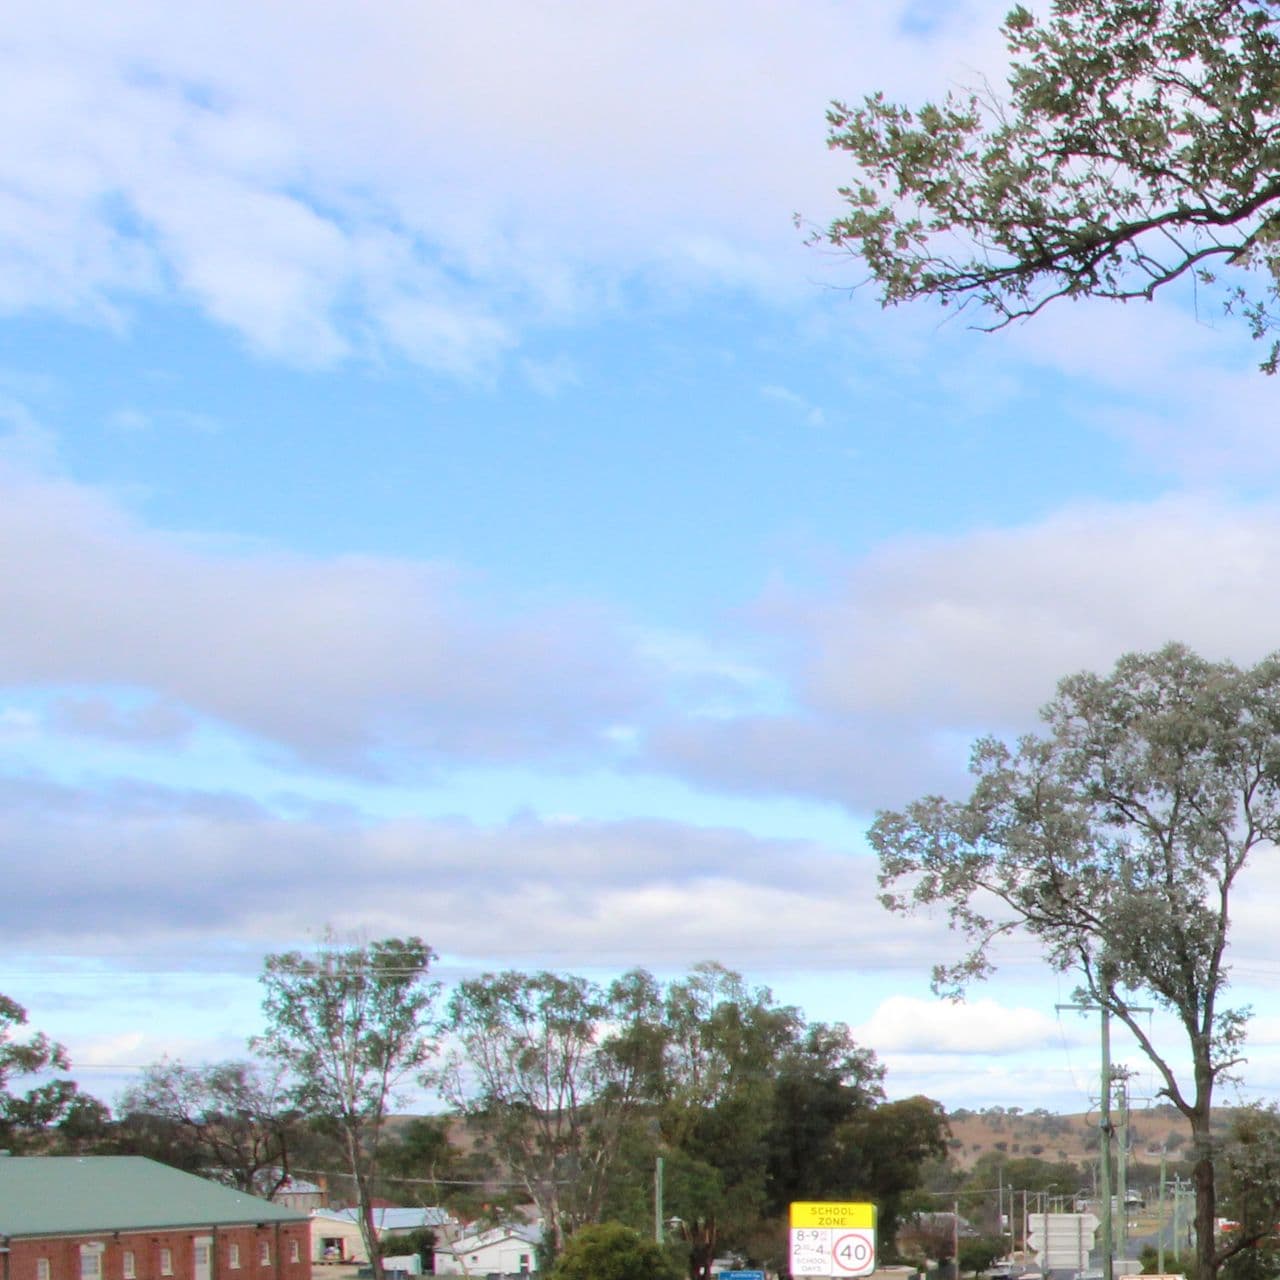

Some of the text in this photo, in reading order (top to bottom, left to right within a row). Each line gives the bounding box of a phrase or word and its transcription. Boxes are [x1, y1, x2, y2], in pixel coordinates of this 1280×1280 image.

[810, 1207, 854, 1216] SCHOOL
[818, 1217, 847, 1225] ZONE
[840, 1244, 866, 1260] 40
